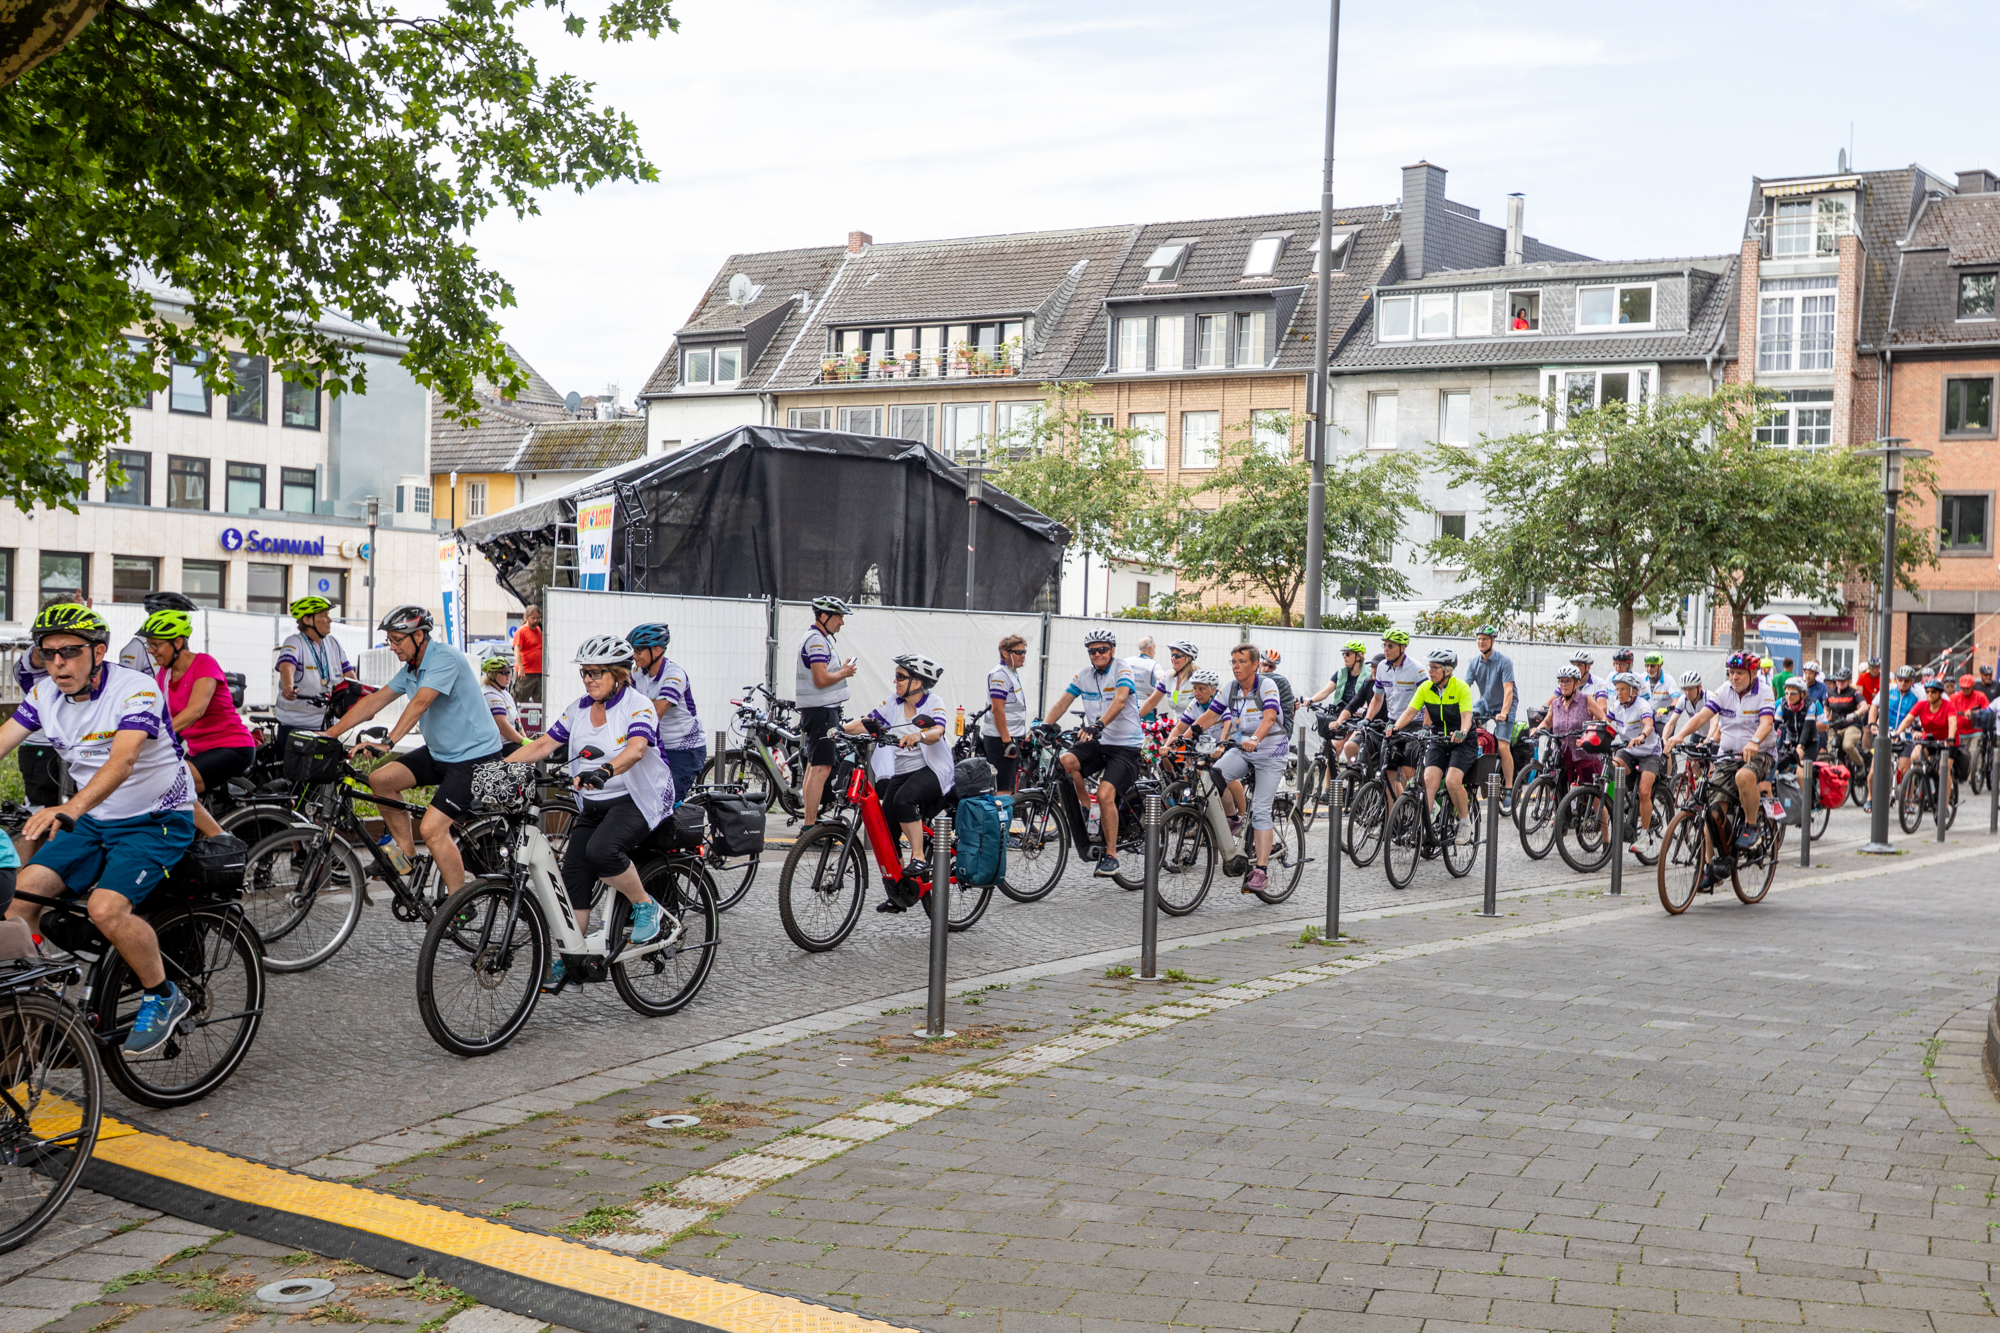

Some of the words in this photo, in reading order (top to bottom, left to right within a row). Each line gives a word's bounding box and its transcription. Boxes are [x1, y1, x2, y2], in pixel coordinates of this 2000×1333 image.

[247, 530, 324, 556] SCHWAN
[591, 544, 604, 559] WDR
[104, 730, 117, 739] LOT
[546, 870, 575, 931] KTM
